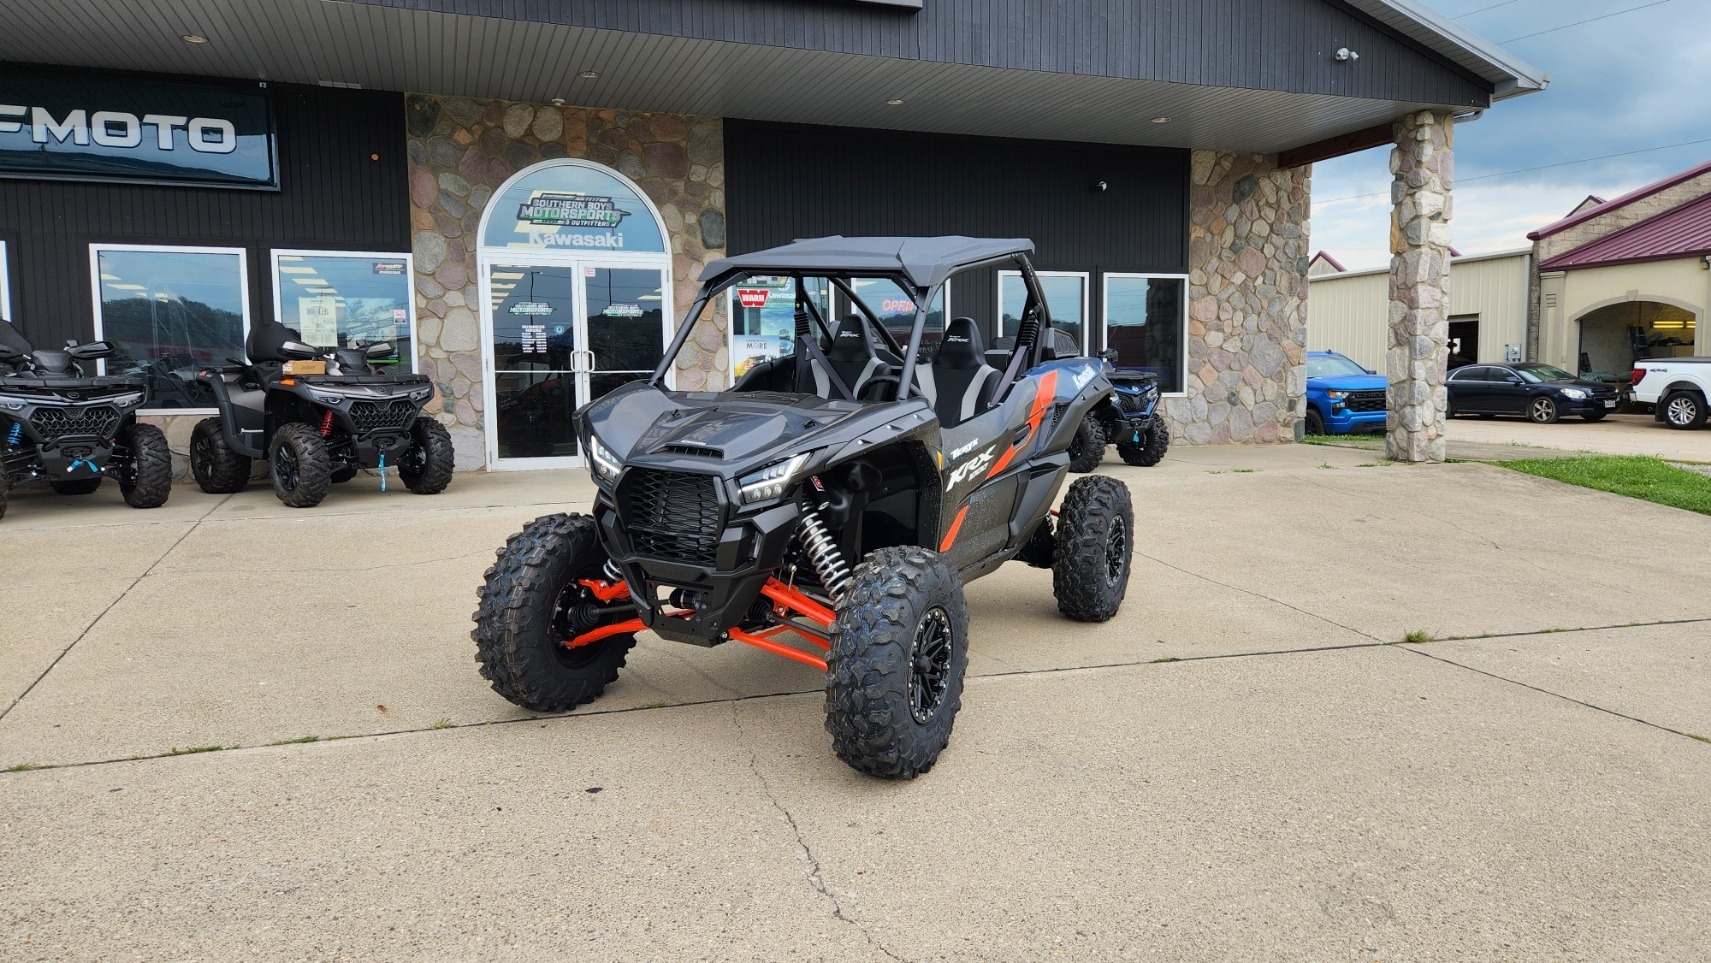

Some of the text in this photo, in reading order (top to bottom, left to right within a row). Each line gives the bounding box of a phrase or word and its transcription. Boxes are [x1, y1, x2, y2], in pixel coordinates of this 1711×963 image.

[532, 199, 613, 210] SOUTHERN BOYS
[520, 205, 621, 221] MOTORSPORTS
[528, 231, 624, 248] Kawasaki
[741, 294, 765, 302] WARN
[883, 300, 914, 311] OPEN
[945, 444, 997, 493] KRX
